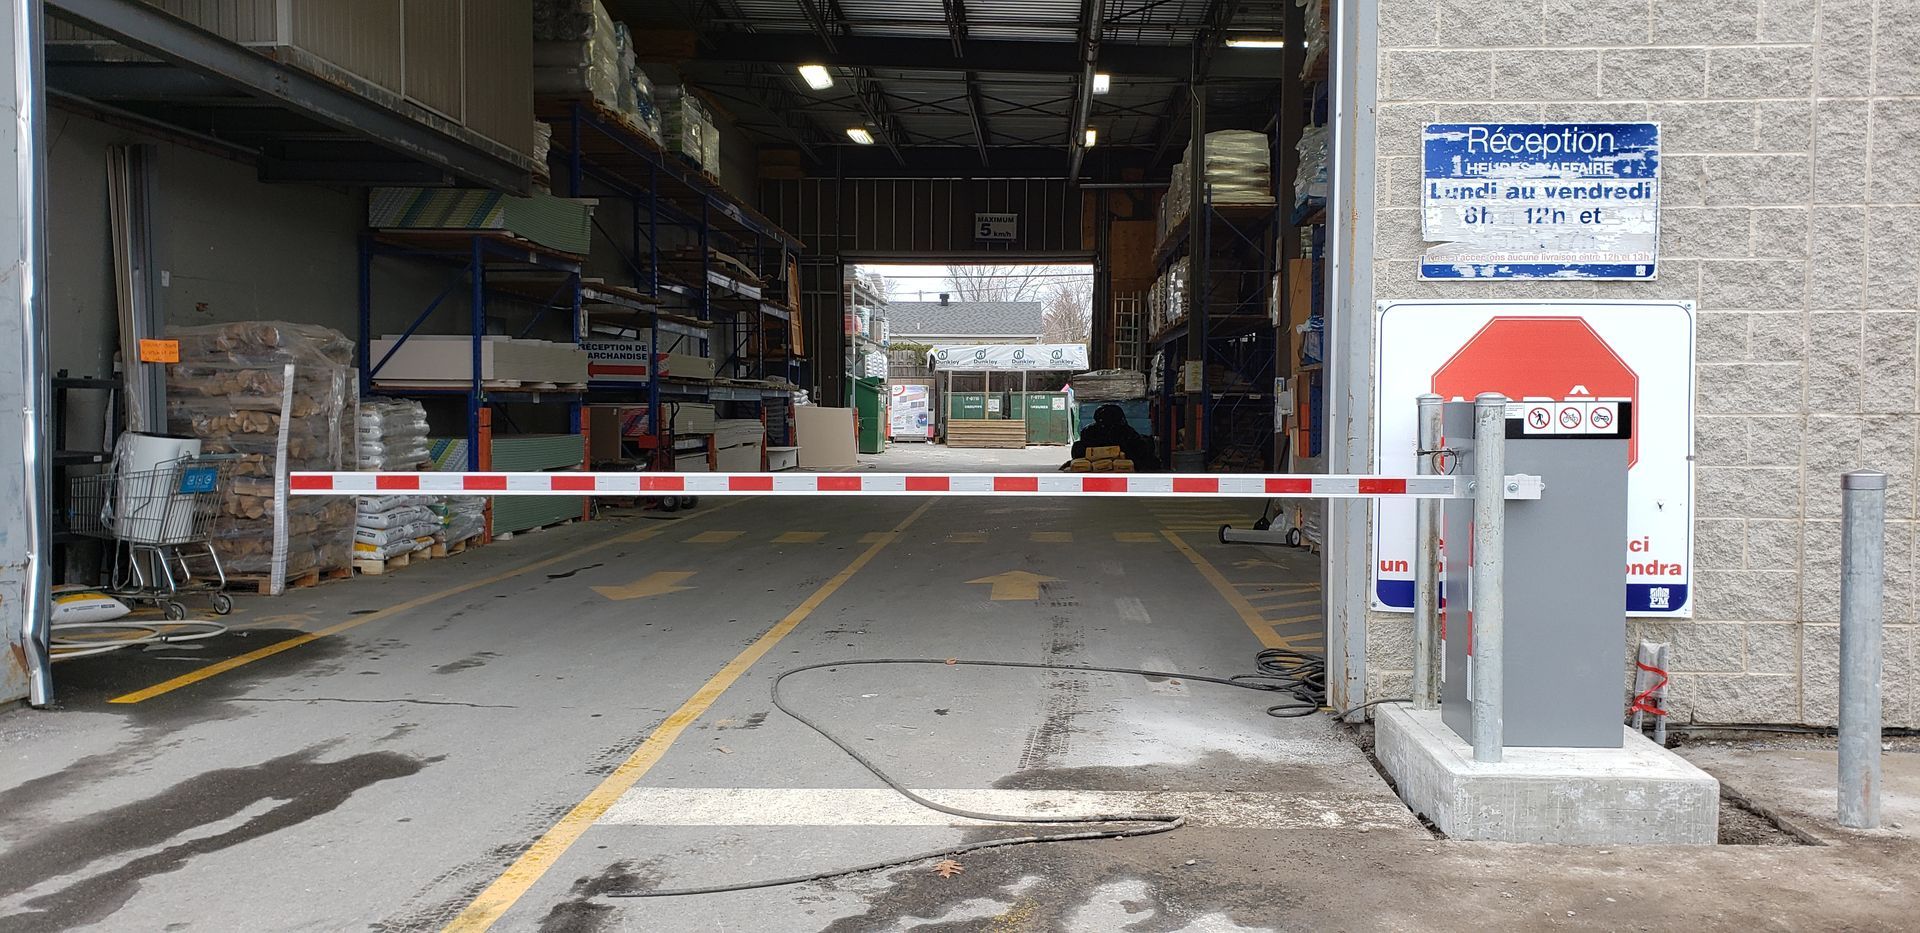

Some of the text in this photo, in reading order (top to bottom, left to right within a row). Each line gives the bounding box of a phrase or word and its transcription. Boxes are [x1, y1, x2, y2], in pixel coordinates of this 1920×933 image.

[1467, 126, 1615, 158] Réception
[1431, 181, 1651, 200] Lundi au vendredi
[1579, 206, 1602, 224] et
[980, 222, 992, 236] 5
[1507, 253, 1539, 262] aucune
[1541, 251, 1577, 262] livraison
[1633, 252, 1650, 261] 13h
[1626, 535, 1650, 553] ci
[1380, 559, 1409, 573] un
[1650, 597, 1670, 605] PM
